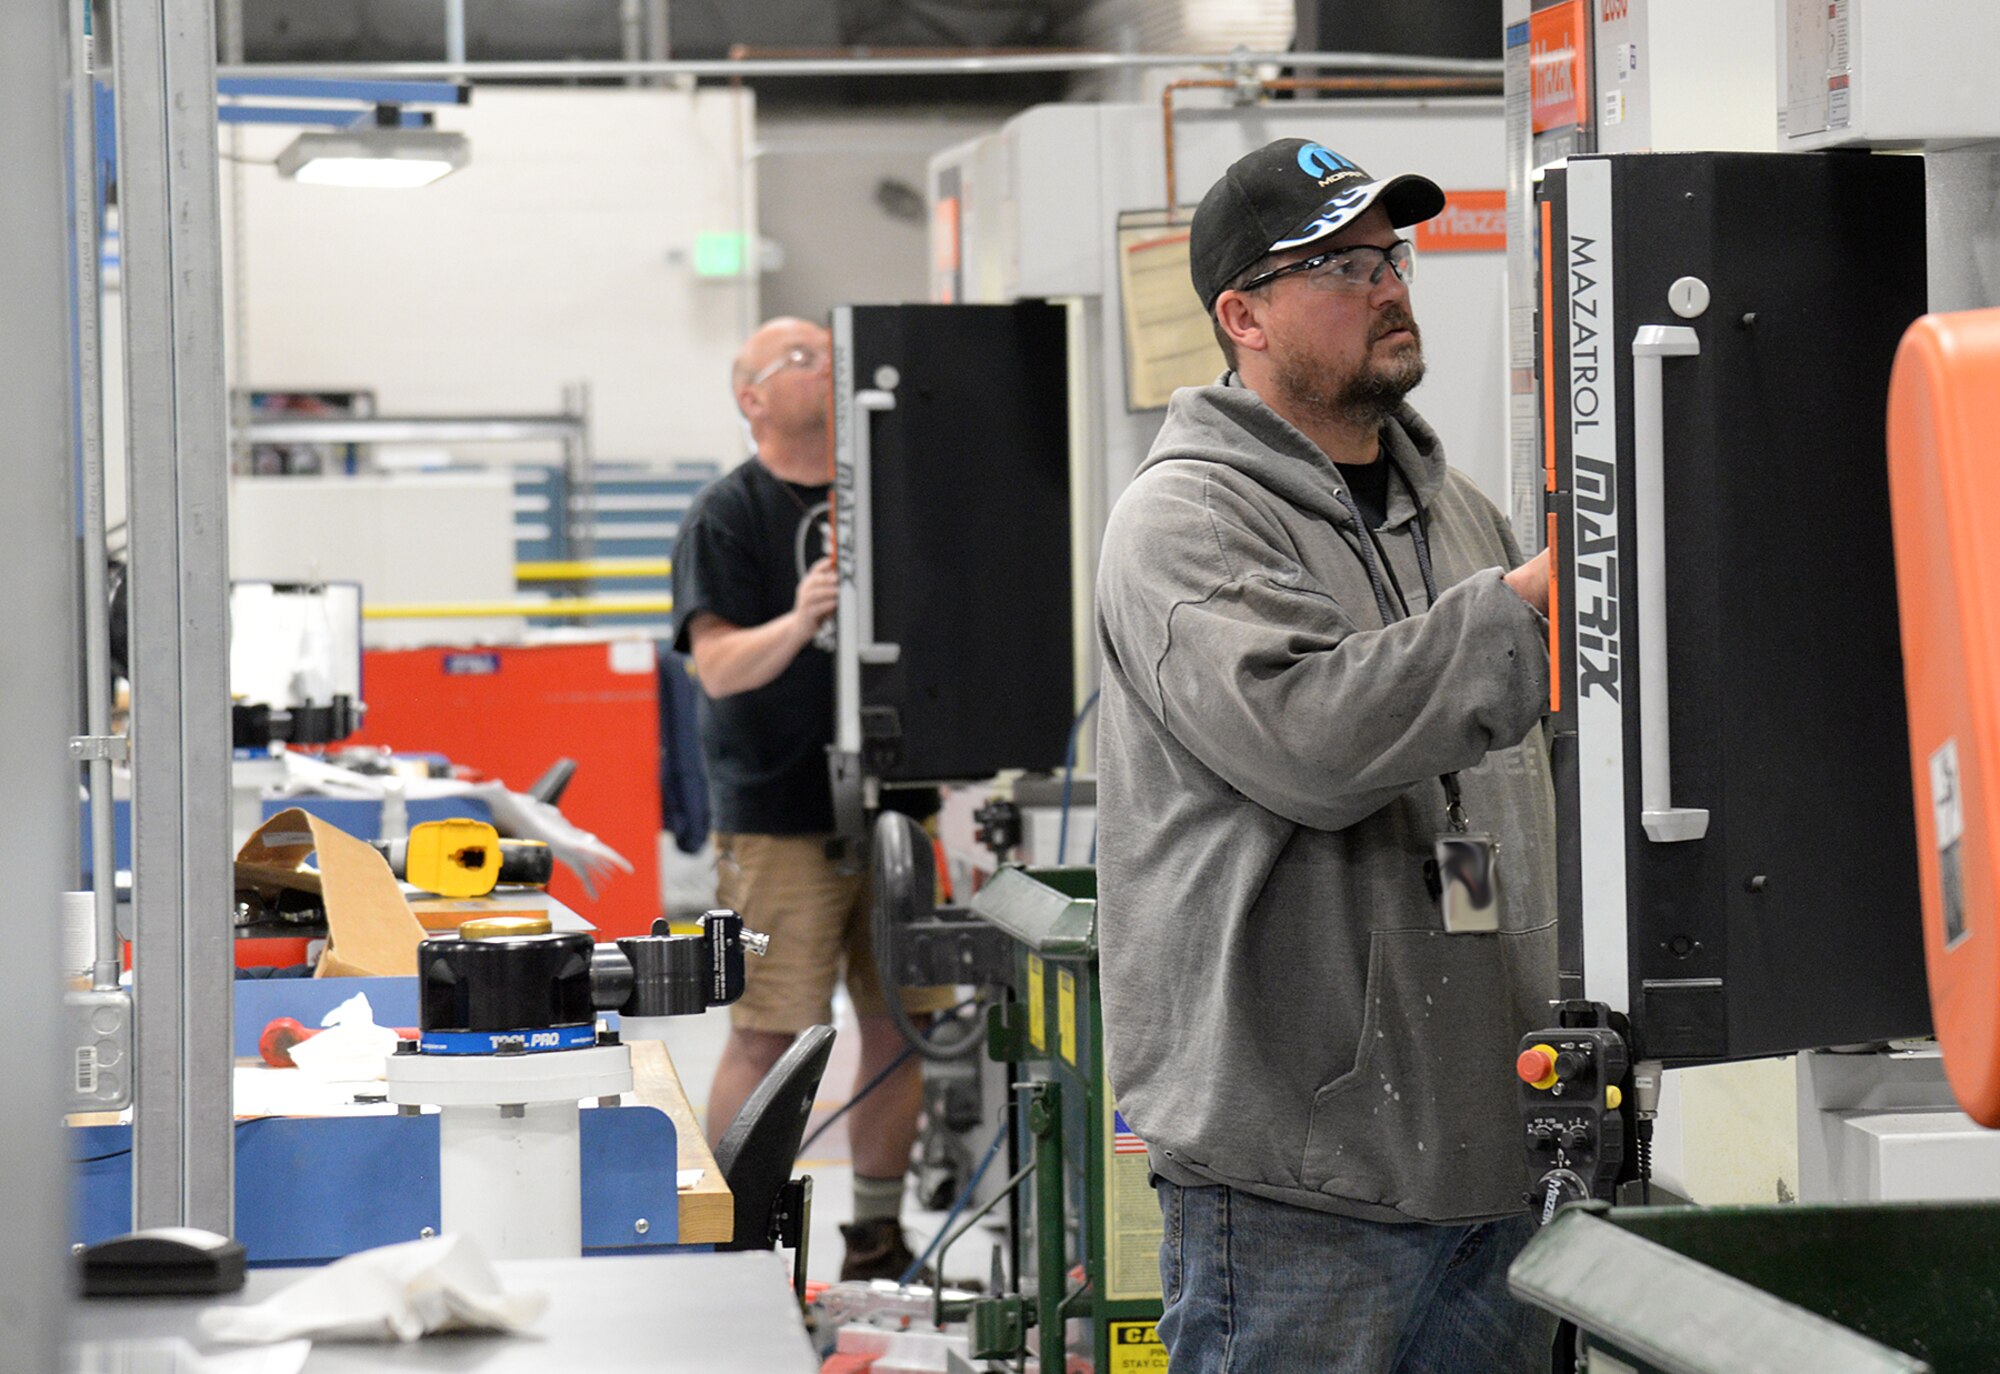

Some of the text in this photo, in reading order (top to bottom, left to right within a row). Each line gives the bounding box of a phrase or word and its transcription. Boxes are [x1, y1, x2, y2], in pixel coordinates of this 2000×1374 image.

[1427, 207, 1506, 236] Maza
[1570, 234, 1621, 705] MAZATROL MATRIX
[531, 1032, 560, 1048] PRO
[1125, 1328, 1161, 1343] CA
[1122, 1359, 1168, 1368] STAY CL
